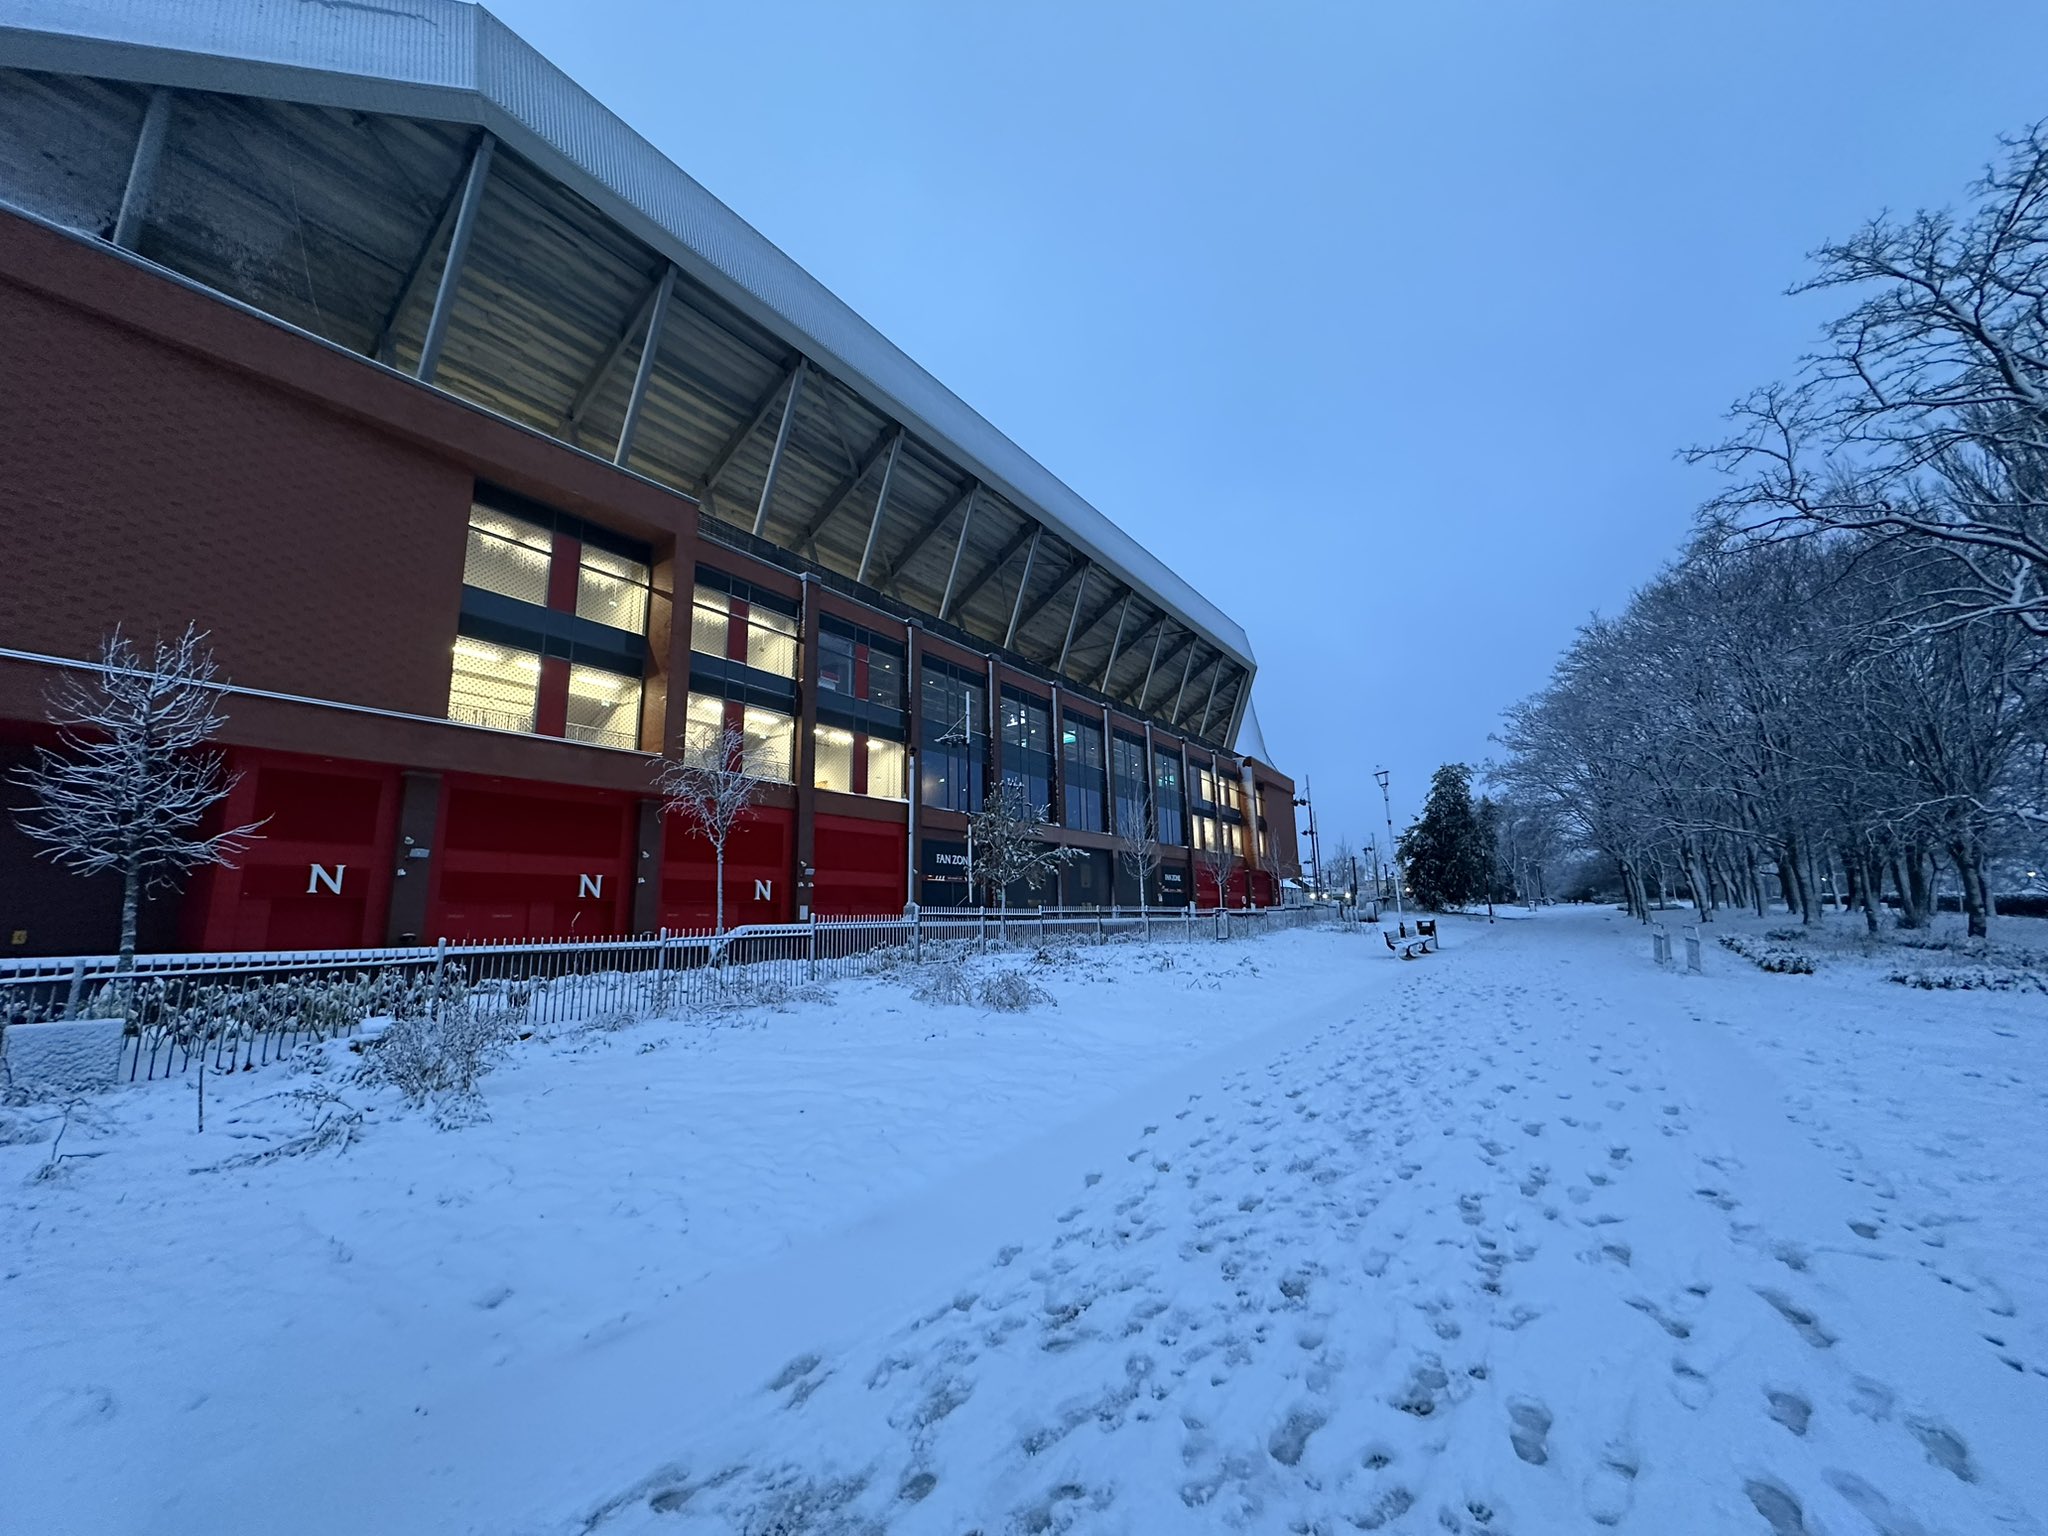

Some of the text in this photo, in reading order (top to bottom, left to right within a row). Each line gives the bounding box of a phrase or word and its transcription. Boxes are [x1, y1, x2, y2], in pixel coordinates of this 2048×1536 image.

[936, 853, 970, 865] FAN ZON
[306, 863, 347, 895] N
[578, 873, 603, 899] N
[754, 879, 772, 901] N
